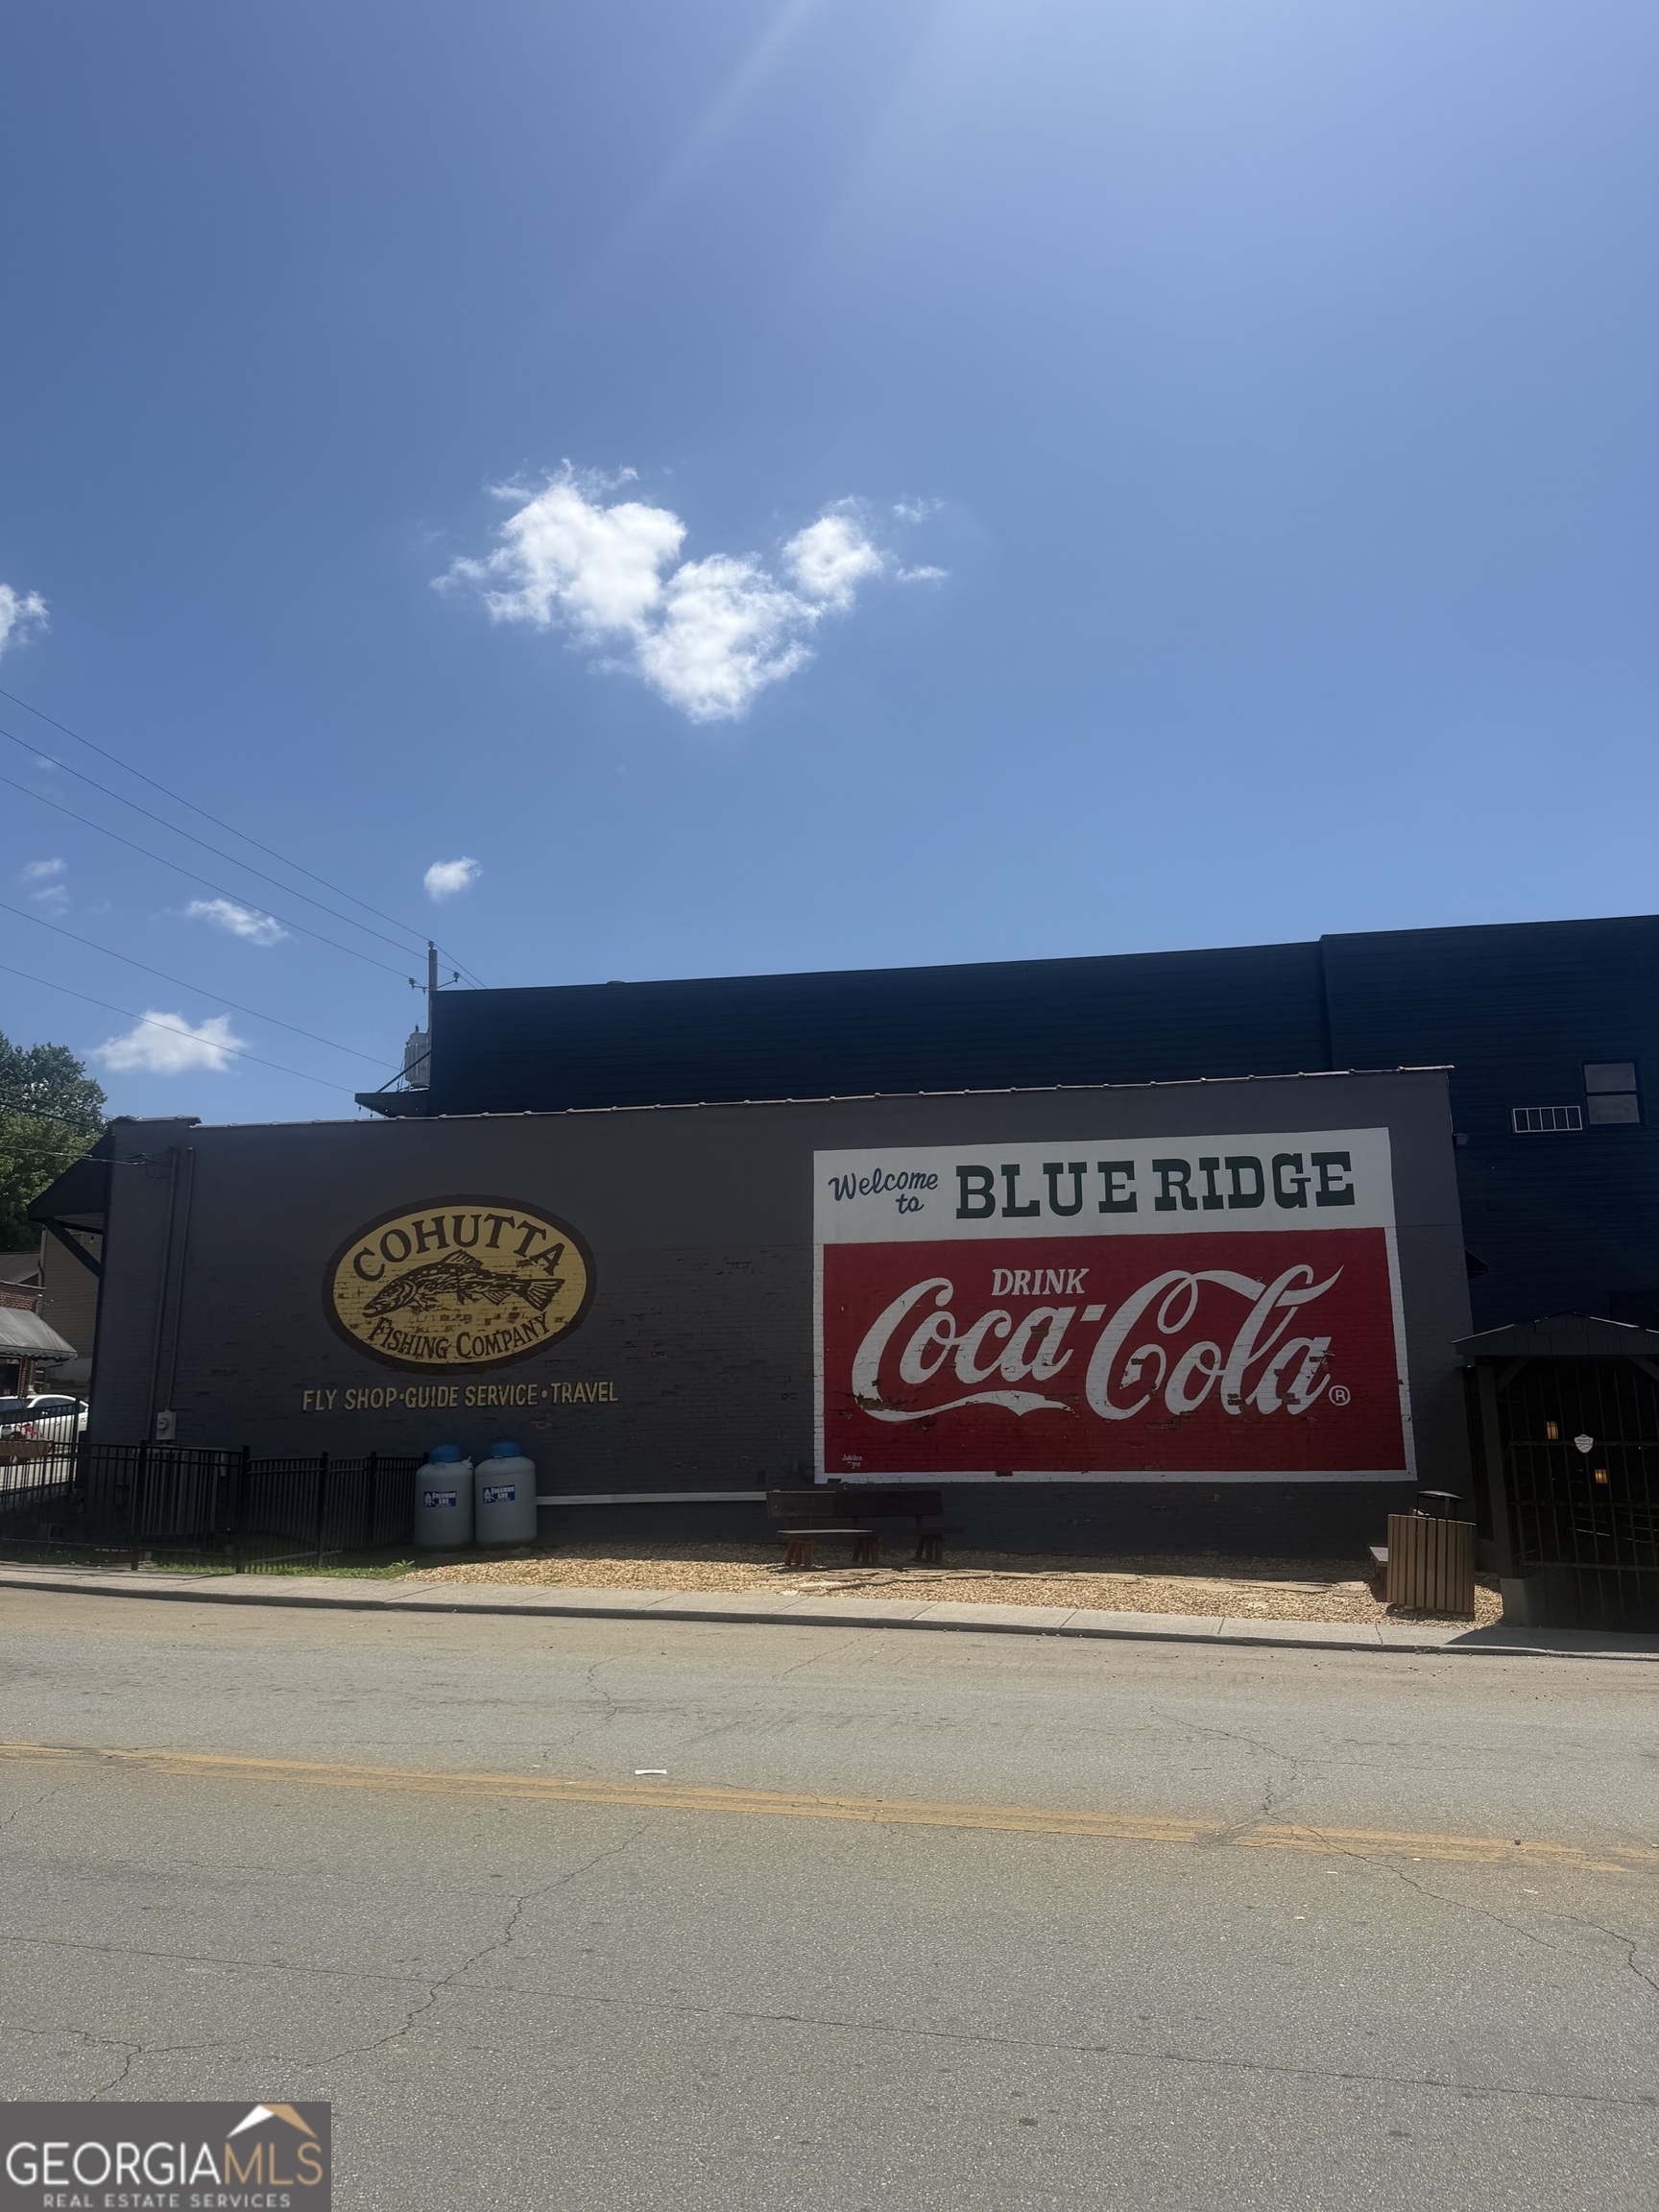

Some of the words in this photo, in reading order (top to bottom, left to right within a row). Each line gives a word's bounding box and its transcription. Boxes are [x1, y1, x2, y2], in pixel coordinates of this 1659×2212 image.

[828, 1167, 939, 1202] Welcome
[895, 1194, 926, 1214] to
[955, 1160, 1139, 1219] BLUE
[1152, 1150, 1357, 1213] RIDGE
[353, 1214, 565, 1282] COHUTTA
[991, 1267, 1090, 1297] DRINK
[455, 1310, 550, 1359] COMPANY
[851, 1263, 1344, 1422] Coca-Cola
[301, 1389, 337, 1411] FLY
[464, 1383, 539, 1407] SERVICE
[550, 1382, 619, 1404] TRAVEL
